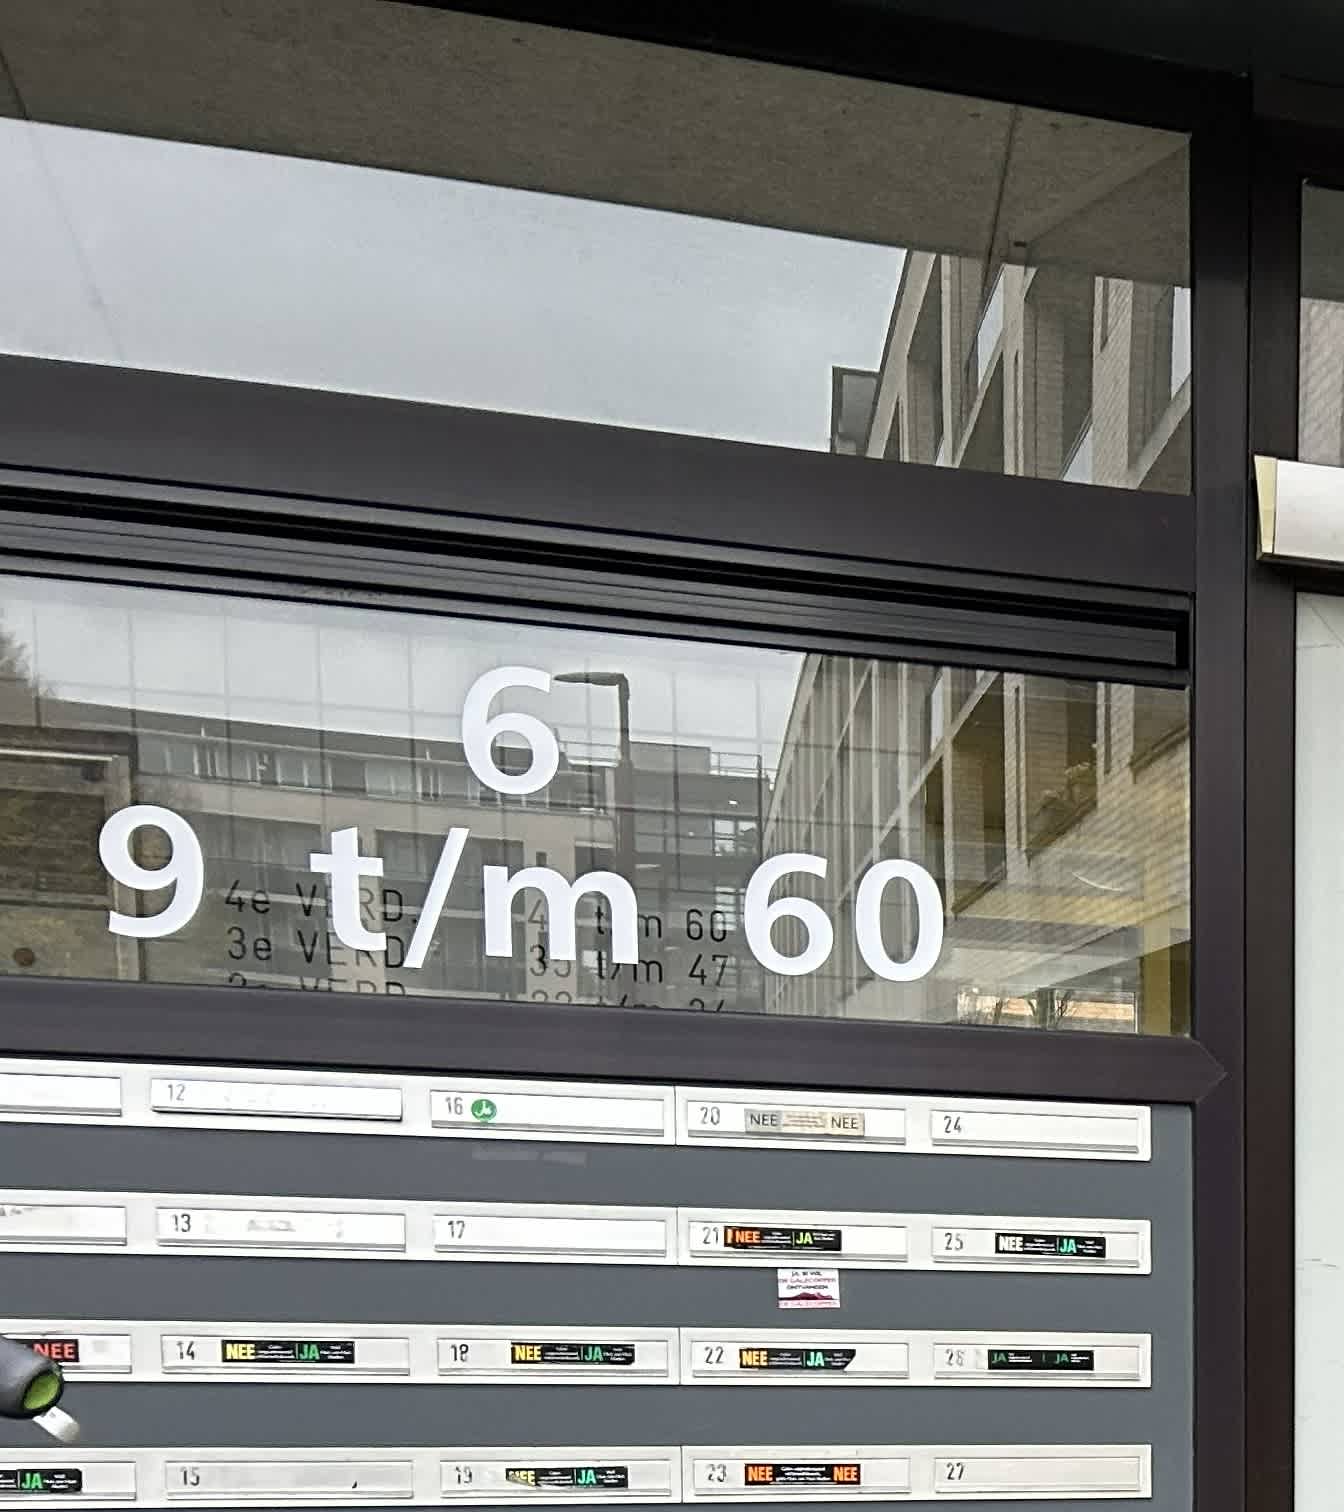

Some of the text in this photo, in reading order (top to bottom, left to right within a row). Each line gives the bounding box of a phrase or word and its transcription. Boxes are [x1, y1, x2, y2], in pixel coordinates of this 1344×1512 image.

[462, 666, 560, 795] 6
[97, 804, 945, 982] 9 t/m 60
[225, 879, 271, 914] 4e
[685, 908, 728, 943] 60
[226, 926, 272, 961] 3e
[688, 954, 729, 986] 47
[167, 1083, 186, 1102] 12
[445, 1096, 463, 1115] 16
[700, 1106, 720, 1126] 20
[750, 1113, 778, 1127] NEE
[831, 1116, 859, 1130] NEE
[943, 1115, 962, 1134] 24
[172, 1213, 192, 1233] 13
[447, 1220, 465, 1240] 17
[702, 1226, 719, 1245] 21
[735, 1229, 761, 1243] NEE
[795, 1231, 813, 1245] JA
[944, 1232, 963, 1251] 25
[998, 1235, 1024, 1252] NEE
[1059, 1238, 1077, 1254] JA
[33, 1343, 76, 1359] NEE
[176, 1341, 196, 1361] 14
[225, 1343, 256, 1360] NEE
[299, 1343, 320, 1360] JA
[513, 1344, 542, 1361] NEE
[583, 1345, 603, 1361] JA
[704, 1345, 724, 1365] 22
[741, 1350, 768, 1366] NEE
[806, 1351, 825, 1367] JA
[991, 1352, 1008, 1365] JA
[1054, 1353, 1070, 1365] JA
[21, 1472, 44, 1489] JA
[180, 1466, 200, 1486] 15
[577, 1469, 597, 1484] JA
[747, 1466, 773, 1482] NEE
[833, 1466, 858, 1482] NEE
[946, 1462, 965, 1481] 27
